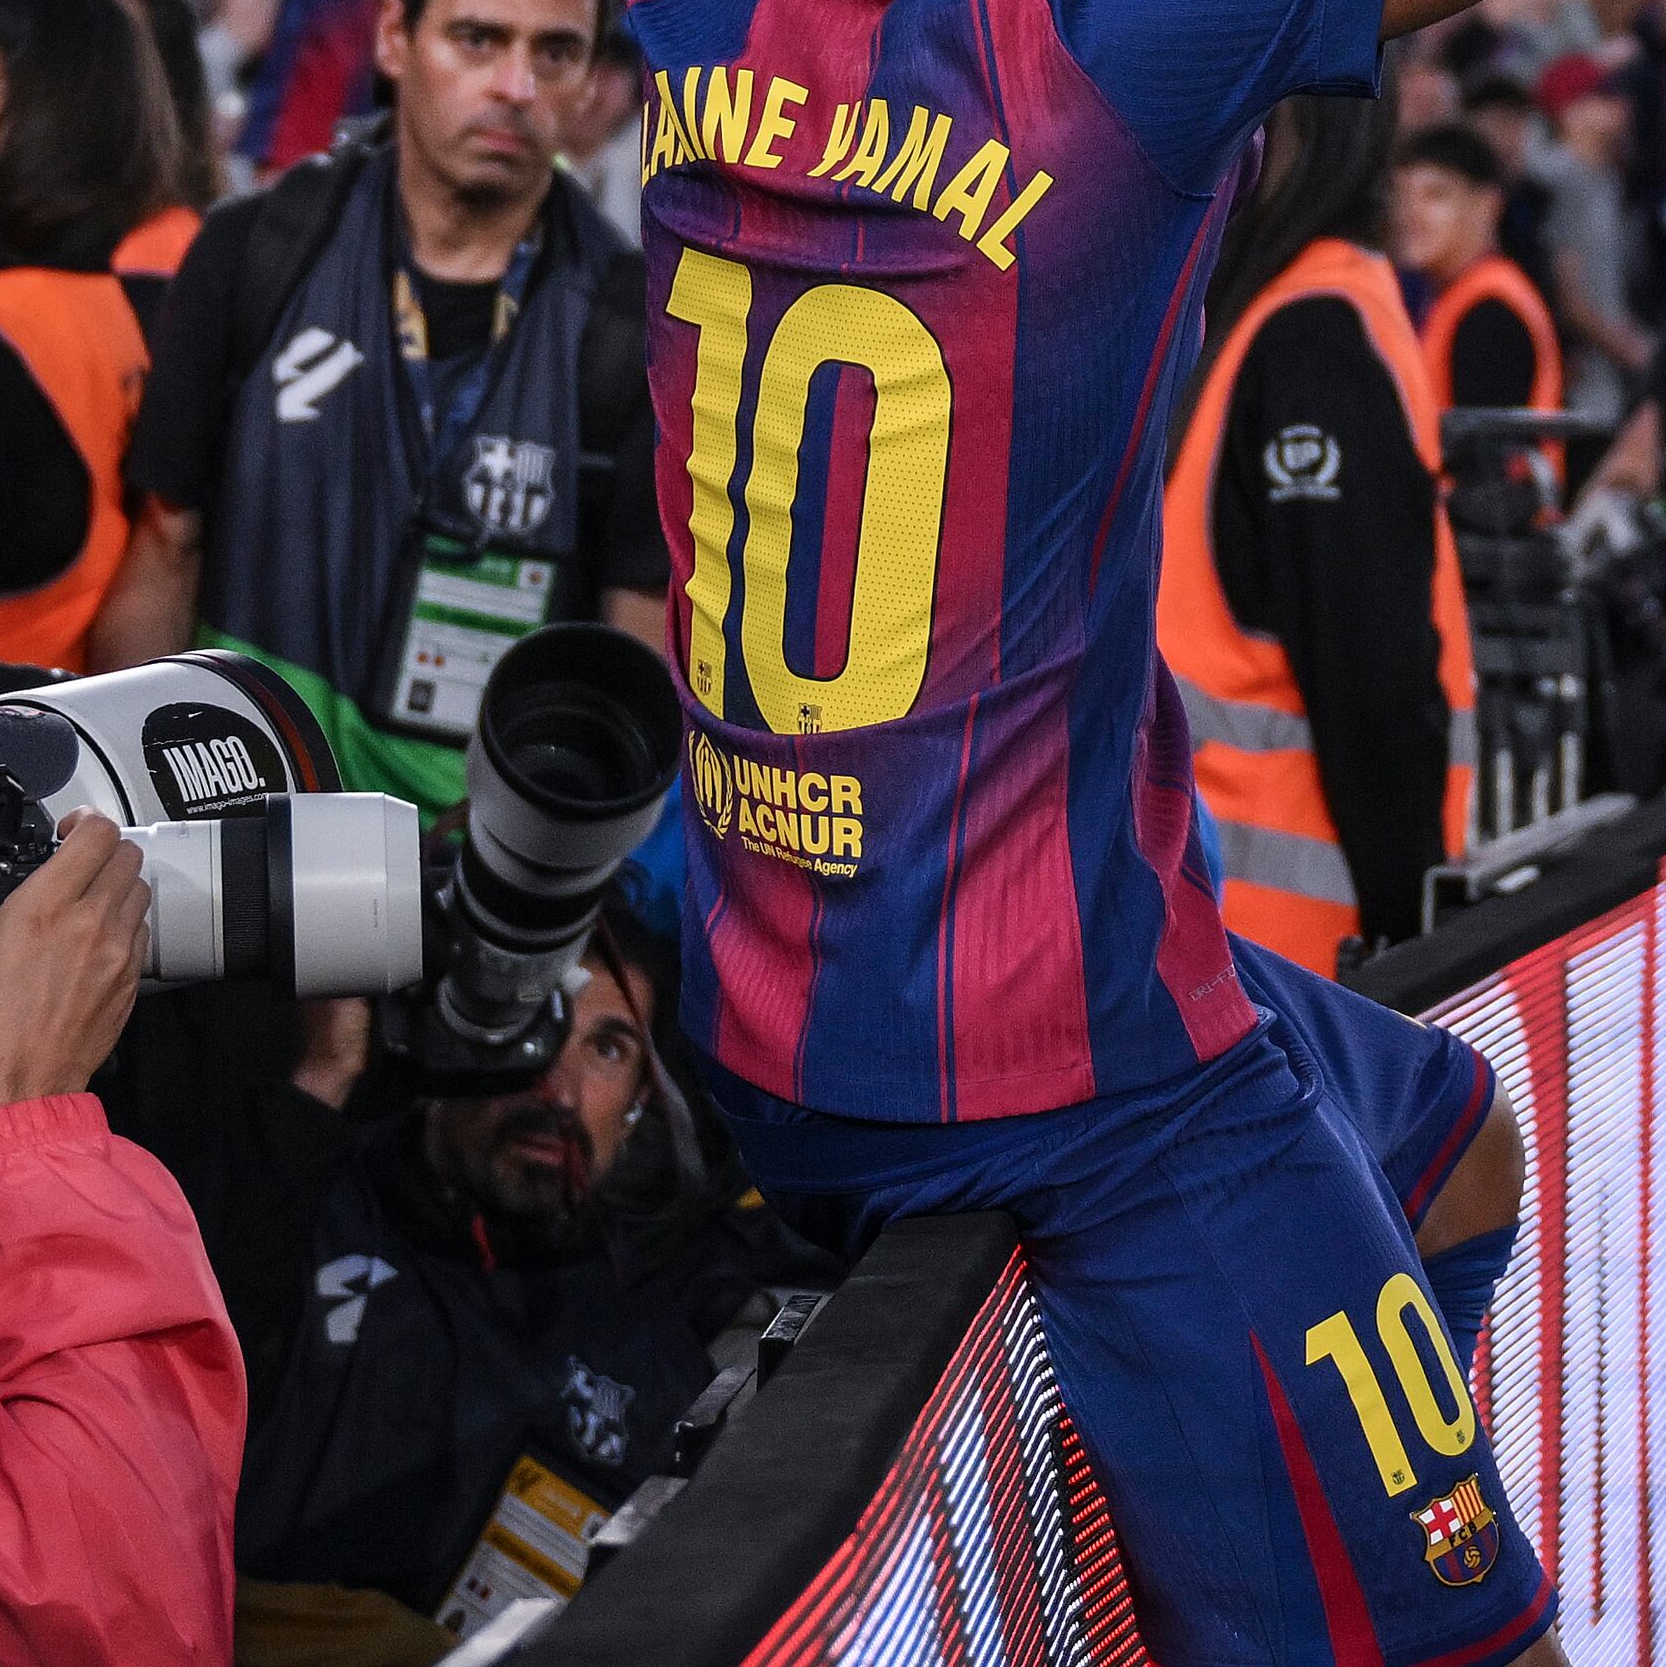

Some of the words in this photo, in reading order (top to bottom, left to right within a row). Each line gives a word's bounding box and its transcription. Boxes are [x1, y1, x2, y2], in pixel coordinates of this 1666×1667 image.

[807, 98, 1054, 272] YAMAL
[665, 246, 953, 735] 10
[733, 754, 863, 815] UNHCR
[739, 797, 863, 858] ACNUR
[741, 836, 760, 853] The
[760, 841, 777, 858] UN
[813, 858, 858, 878] Agency
[1305, 1272, 1476, 1498] 10
